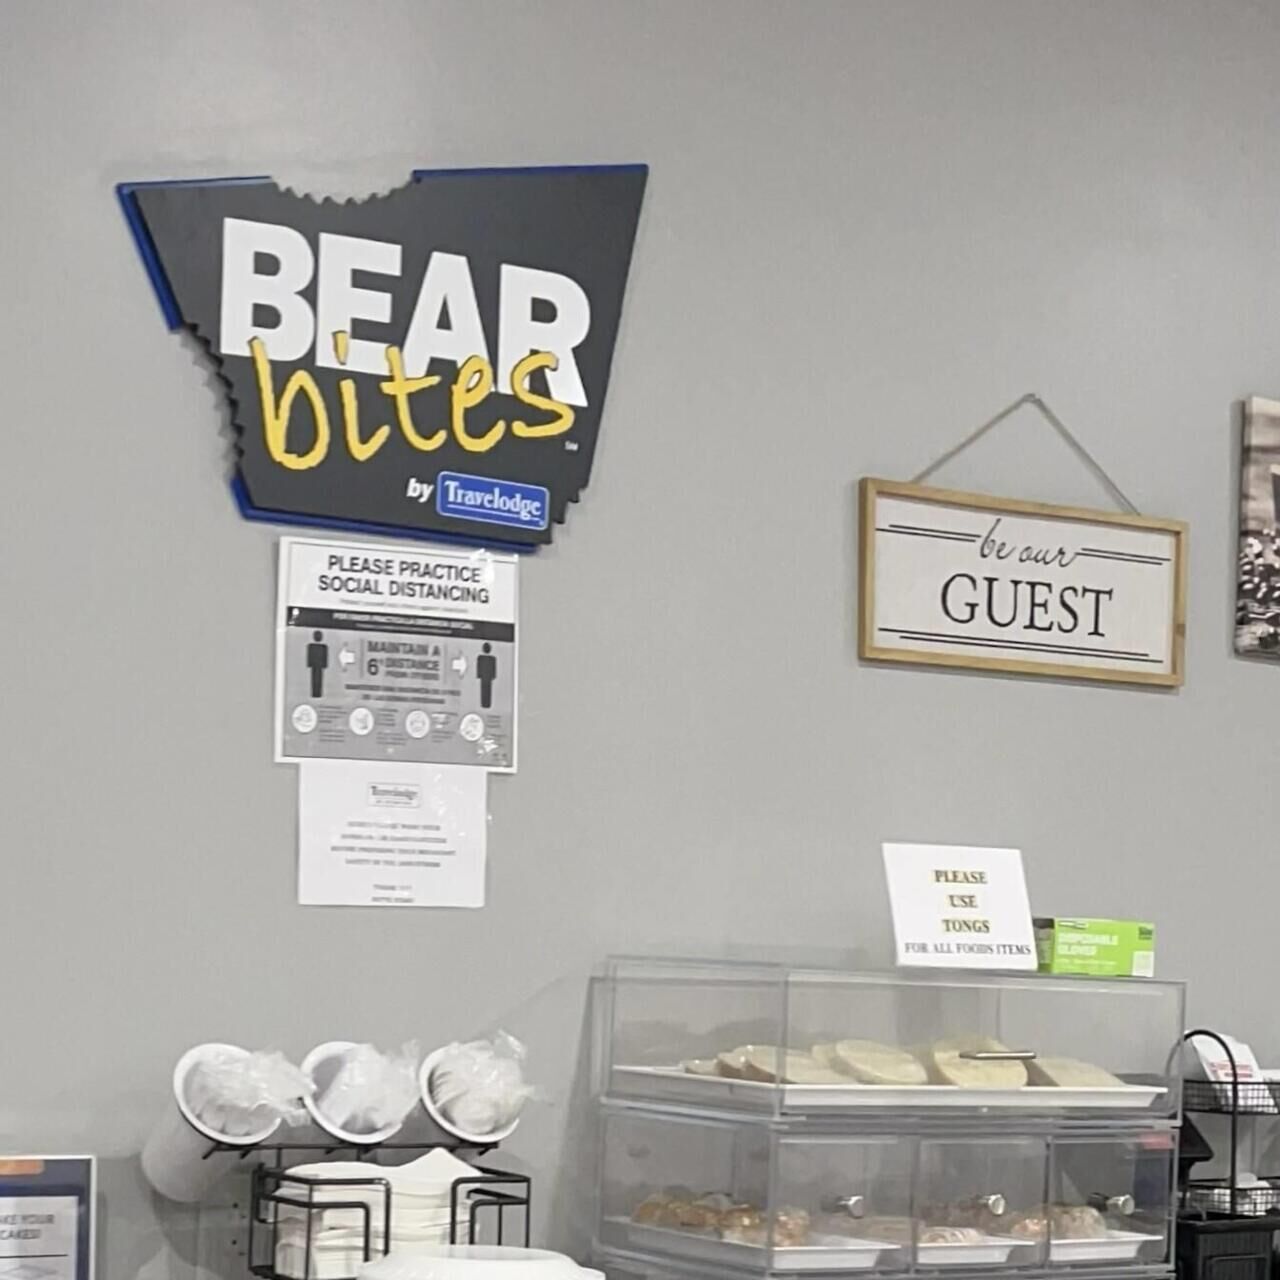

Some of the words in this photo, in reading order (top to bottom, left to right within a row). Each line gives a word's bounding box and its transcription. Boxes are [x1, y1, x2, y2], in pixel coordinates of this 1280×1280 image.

[219, 216, 592, 408] BEAR
[246, 330, 577, 471] bites
[406, 477, 434, 502] by
[444, 480, 541, 519] Travelodge
[979, 517, 1012, 560] be
[1018, 544, 1077, 568] our
[327, 554, 395, 576] PLEASE
[399, 560, 481, 583] PRACTICE
[318, 574, 384, 596] SOCIAL
[388, 580, 490, 604] DISTANCING
[940, 573, 1114, 638] GUEST
[432, 645, 441, 657] A
[933, 869, 988, 885] PLEASE
[948, 894, 978, 909] USE
[941, 919, 990, 934] TONGS
[904, 942, 929, 954] FOR
[933, 943, 952, 955] ALL
[956, 943, 994, 955] FOODS
[996, 944, 1031, 956] ITEMS
